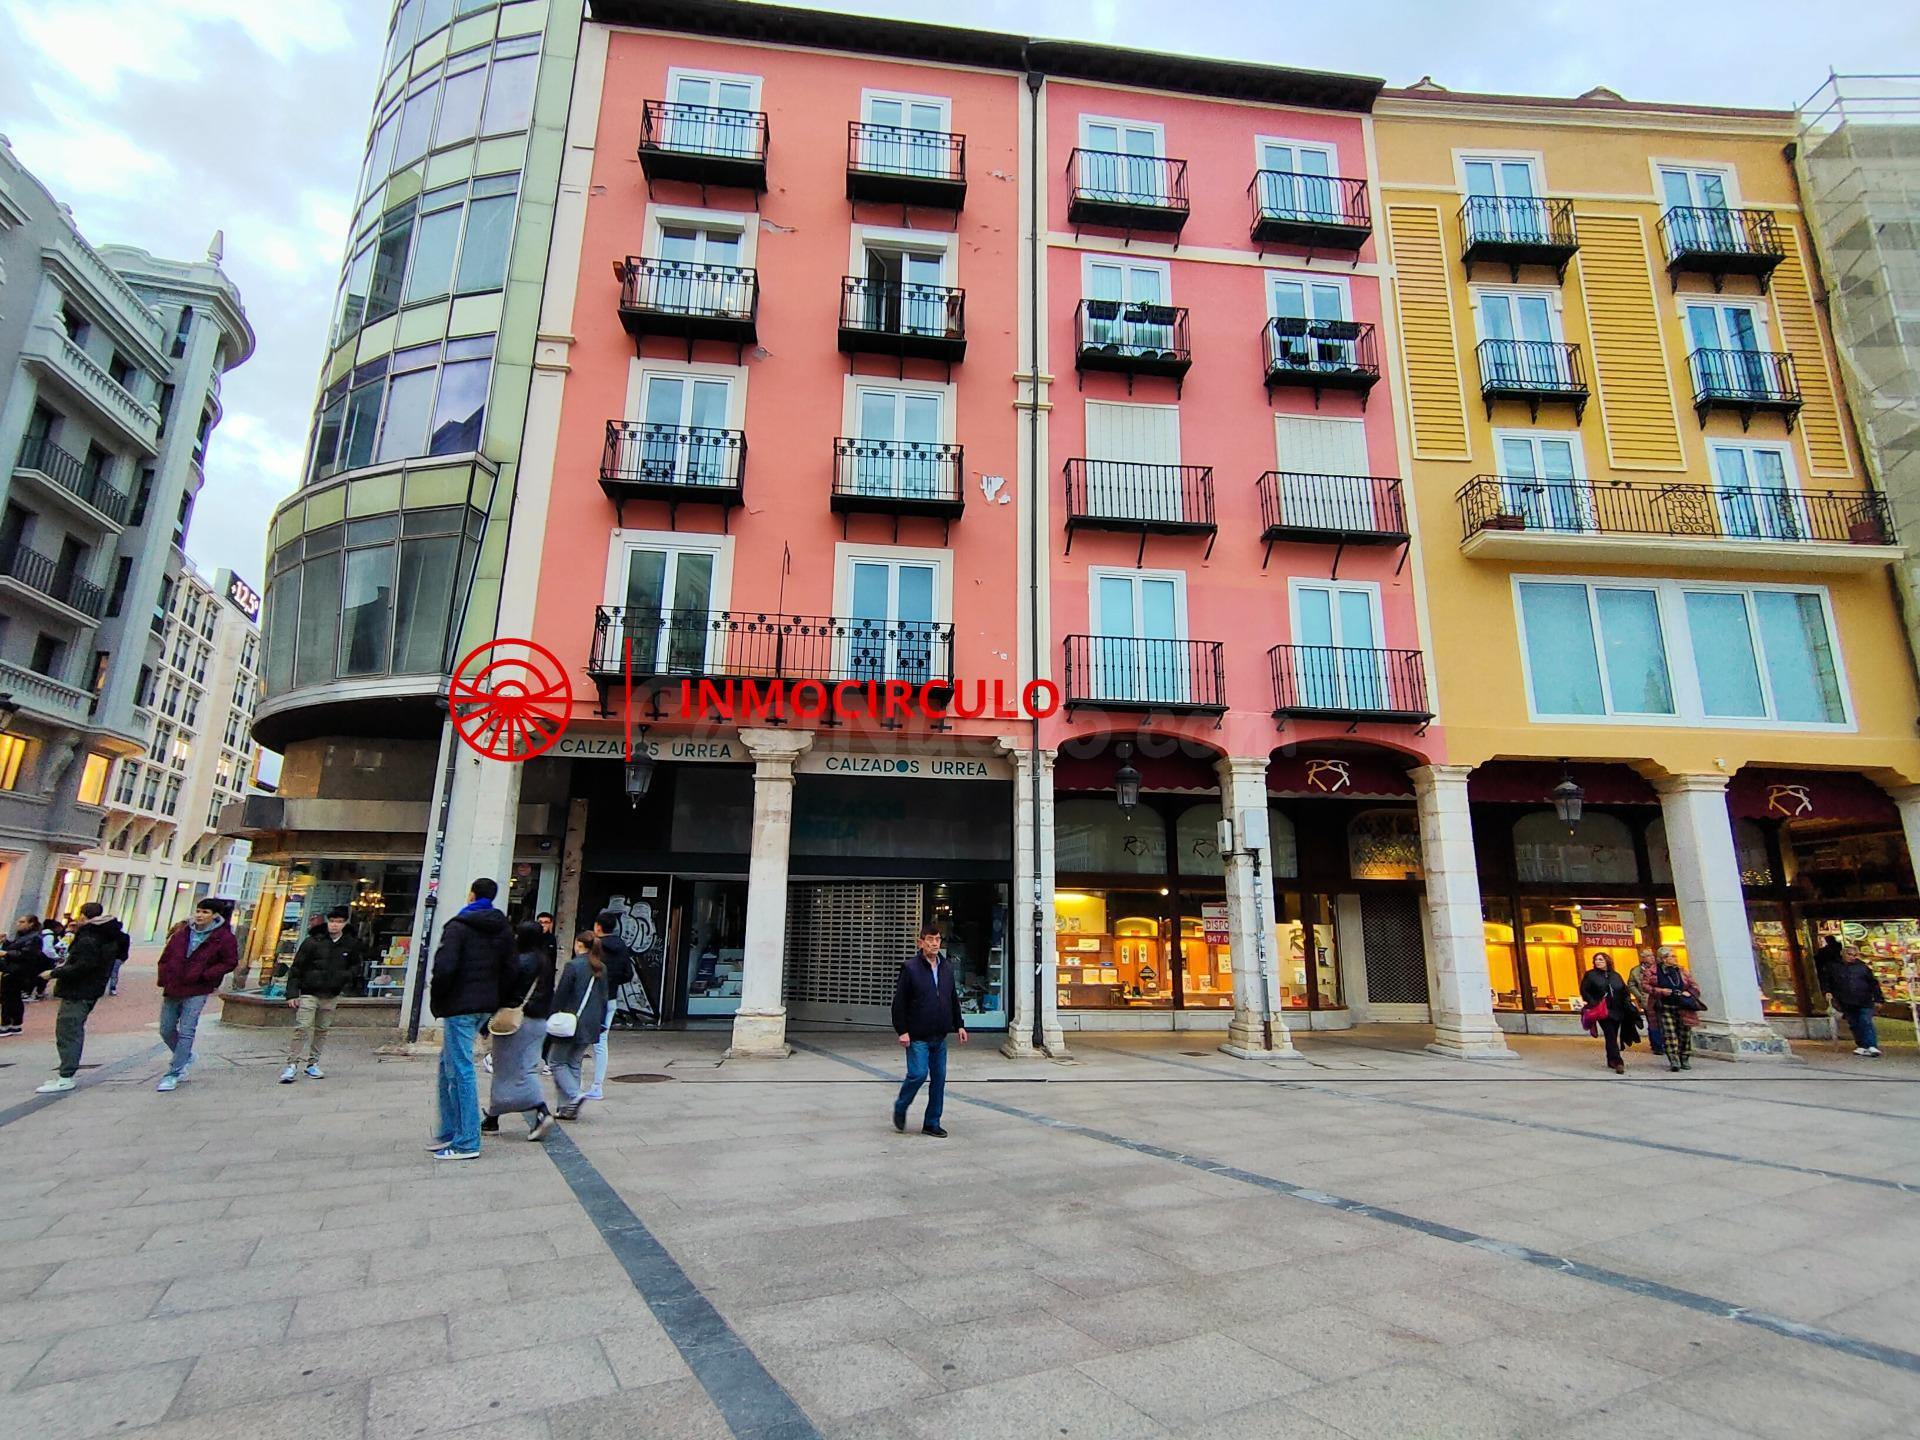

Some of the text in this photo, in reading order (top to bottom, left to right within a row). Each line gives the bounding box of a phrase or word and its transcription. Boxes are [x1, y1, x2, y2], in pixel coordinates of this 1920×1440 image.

[560, 738, 732, 758] CALZADS URREA
[825, 756, 988, 776] CALZADOS URREA
[1205, 920, 1230, 929] DISPO
[1583, 923, 1632, 933] DISPONIBLE
